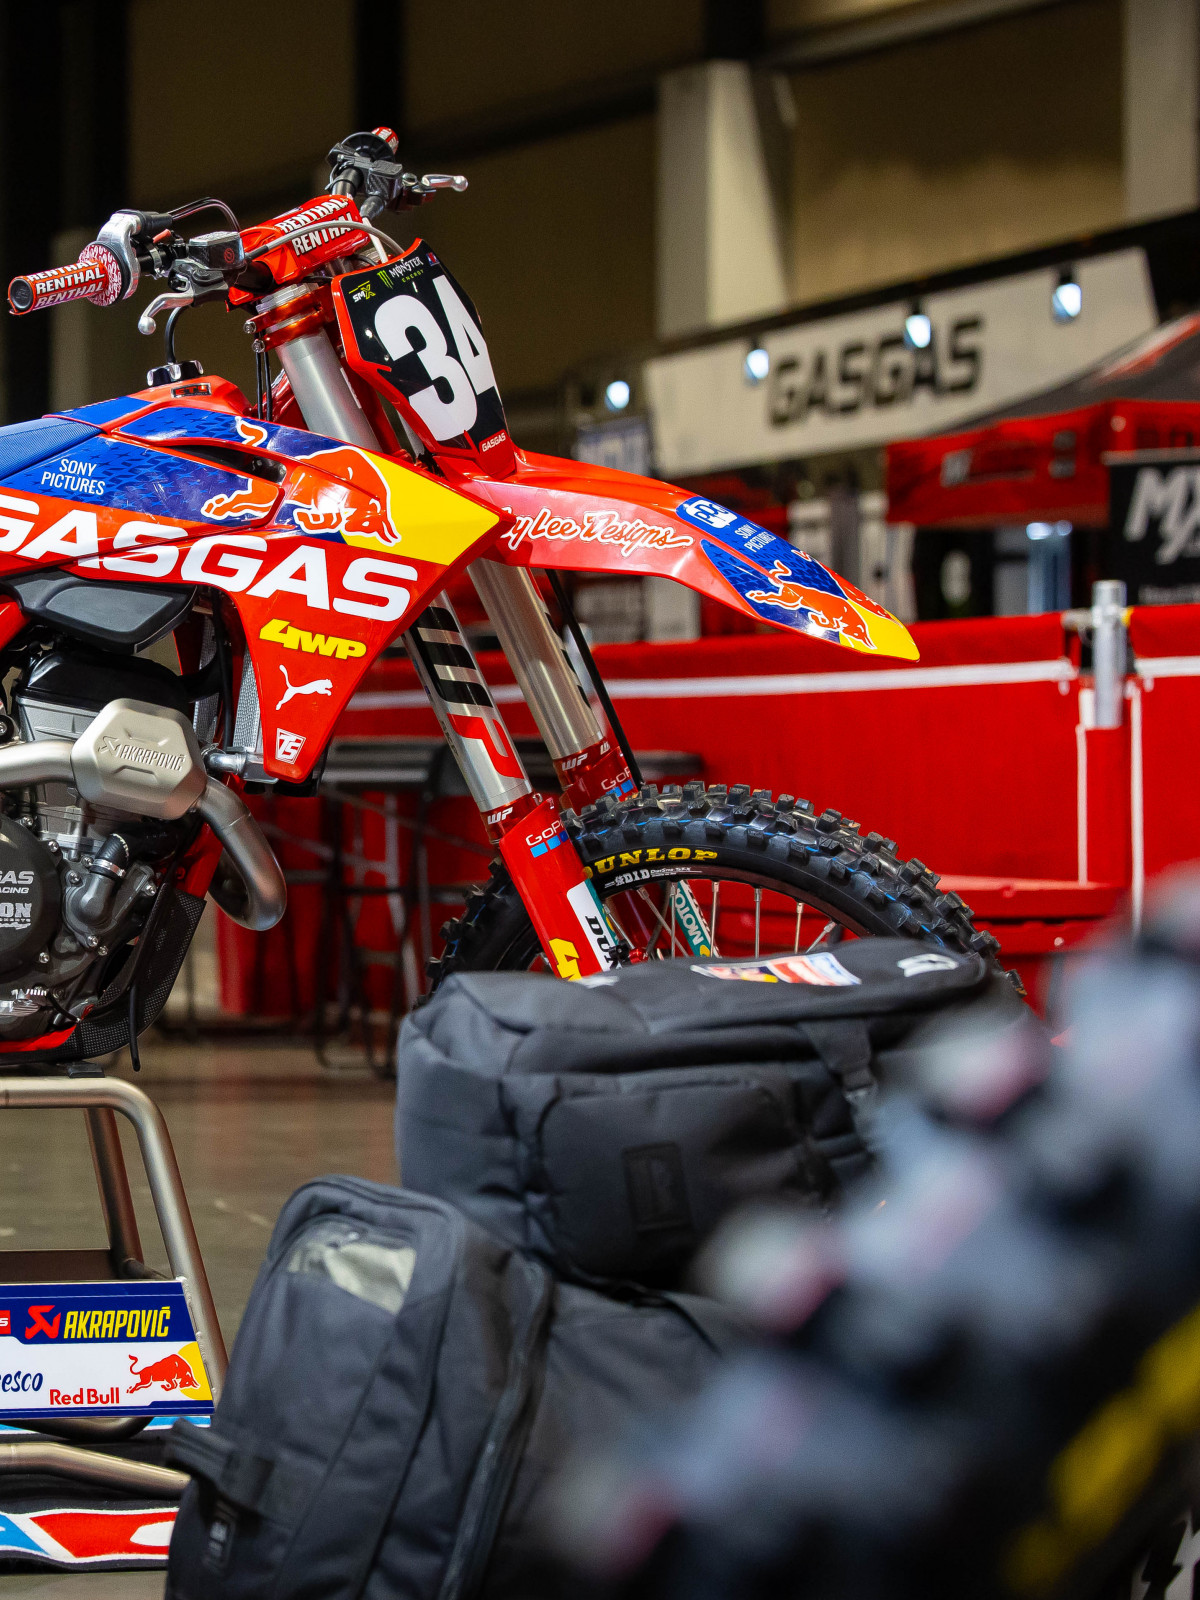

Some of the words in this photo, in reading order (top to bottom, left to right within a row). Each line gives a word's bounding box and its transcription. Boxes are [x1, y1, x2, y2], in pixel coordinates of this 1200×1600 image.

[275, 198, 349, 234] RENTHAL
[27, 259, 99, 282] RENTHAL
[35, 267, 105, 295] RENTHAL
[35, 282, 105, 308] RENTHAL
[374, 274, 497, 442] 34
[768, 311, 984, 431] GASGAS
[481, 432, 506, 452] GASGAS
[59, 458, 97, 477] SONY
[41, 471, 106, 496] PICTURES
[528, 507, 581, 540] Lee
[580, 510, 695, 558] Designs
[562, 753, 588, 772] WP
[487, 807, 513, 825] WP
[525, 821, 564, 847] GoP
[50, 1388, 84, 1405] Red
[86, 1386, 120, 1405] Bull
